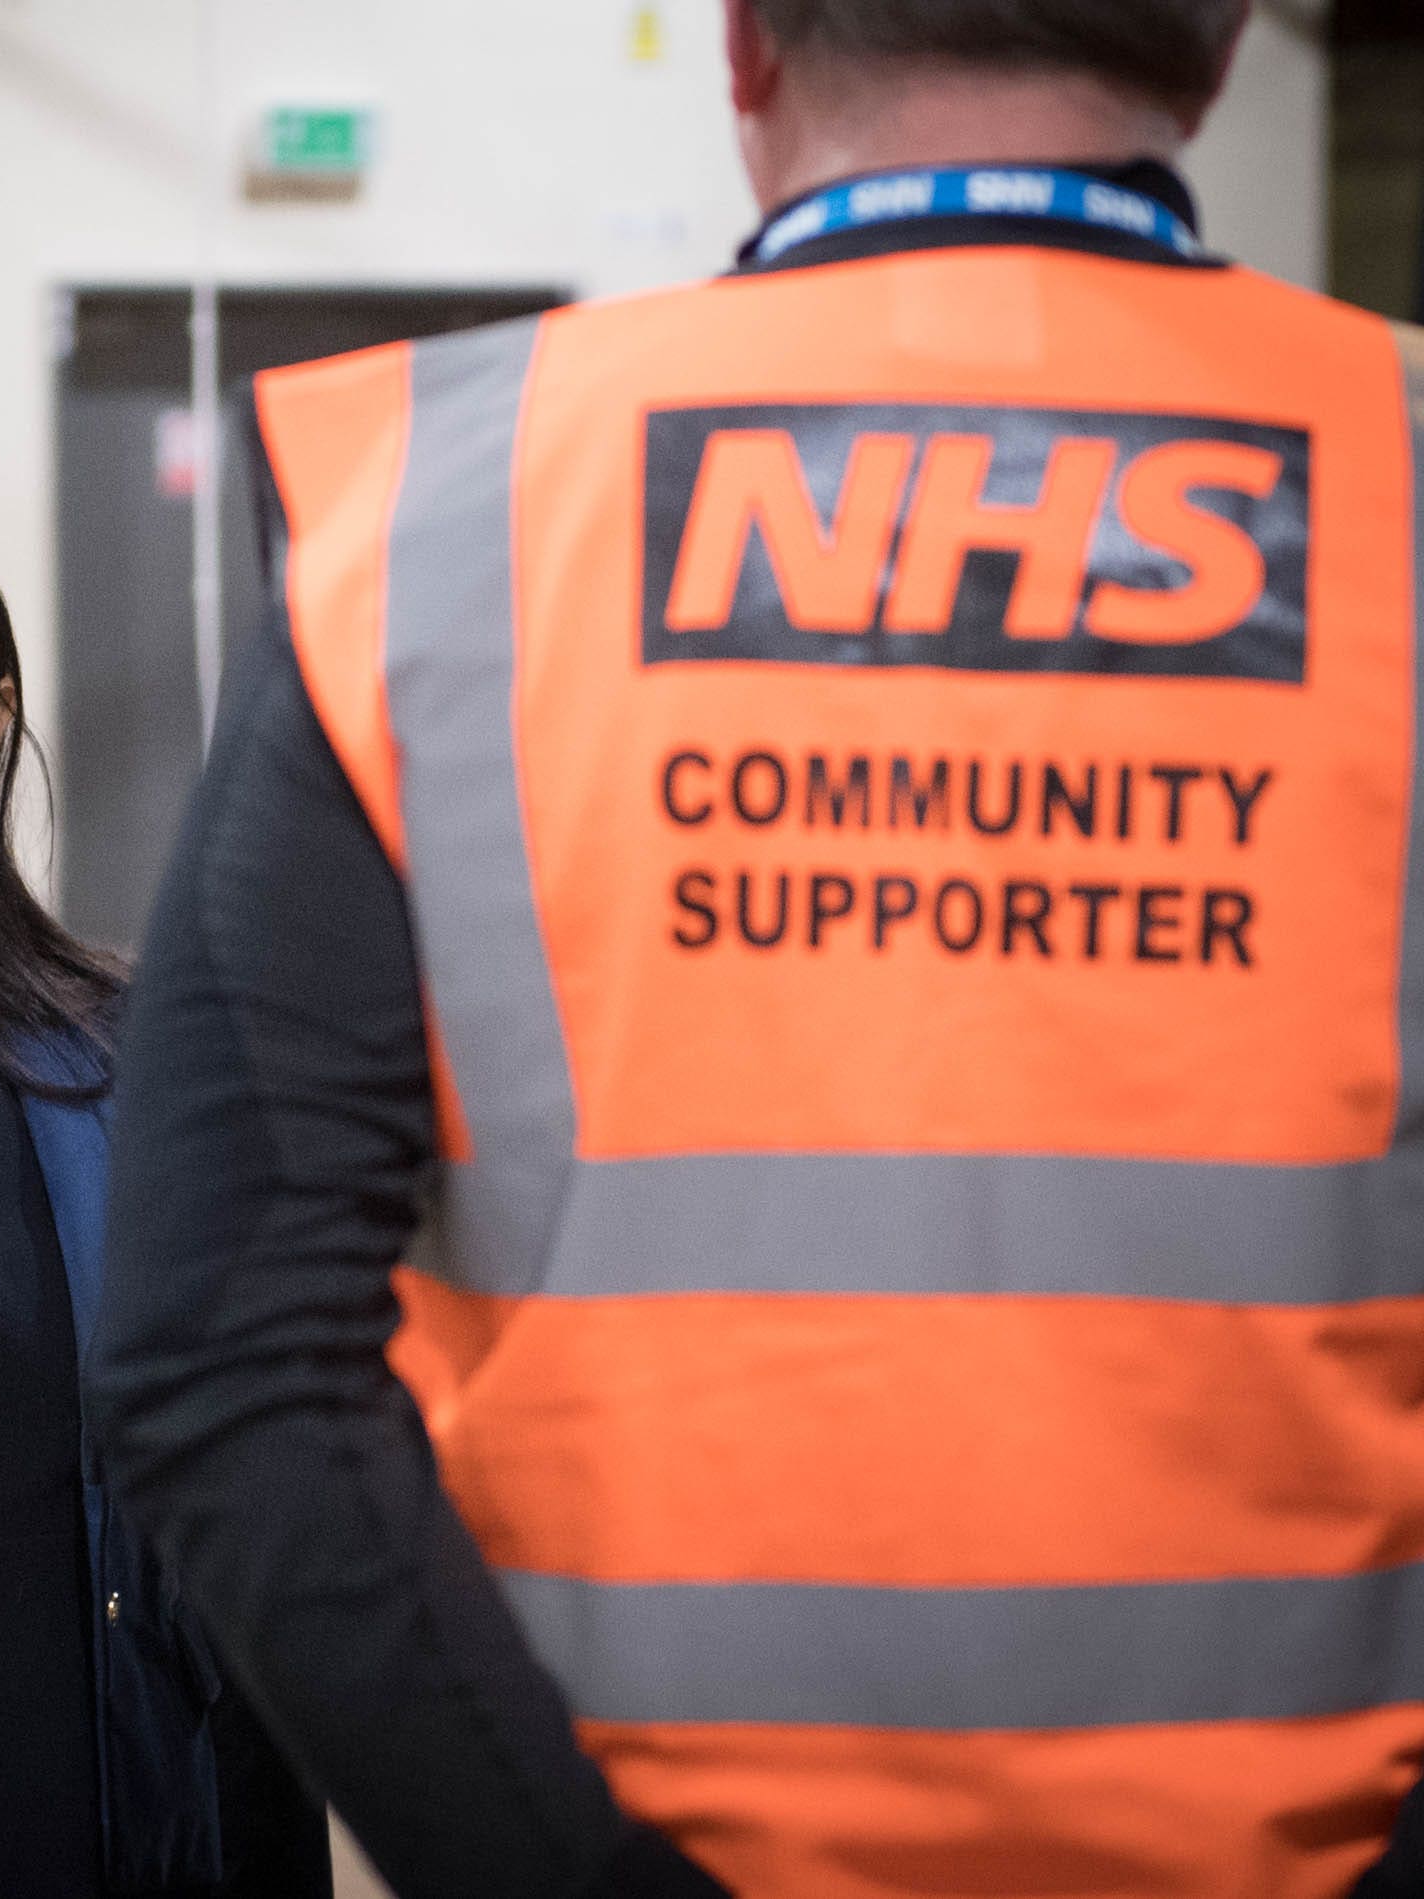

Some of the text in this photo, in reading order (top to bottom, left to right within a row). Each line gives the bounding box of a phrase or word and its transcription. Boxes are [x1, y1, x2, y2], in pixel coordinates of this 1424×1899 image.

[664, 427, 1285, 648] NHS
[662, 751, 1273, 845] COMMUNITY
[670, 869, 1255, 969] SUPPORTER
